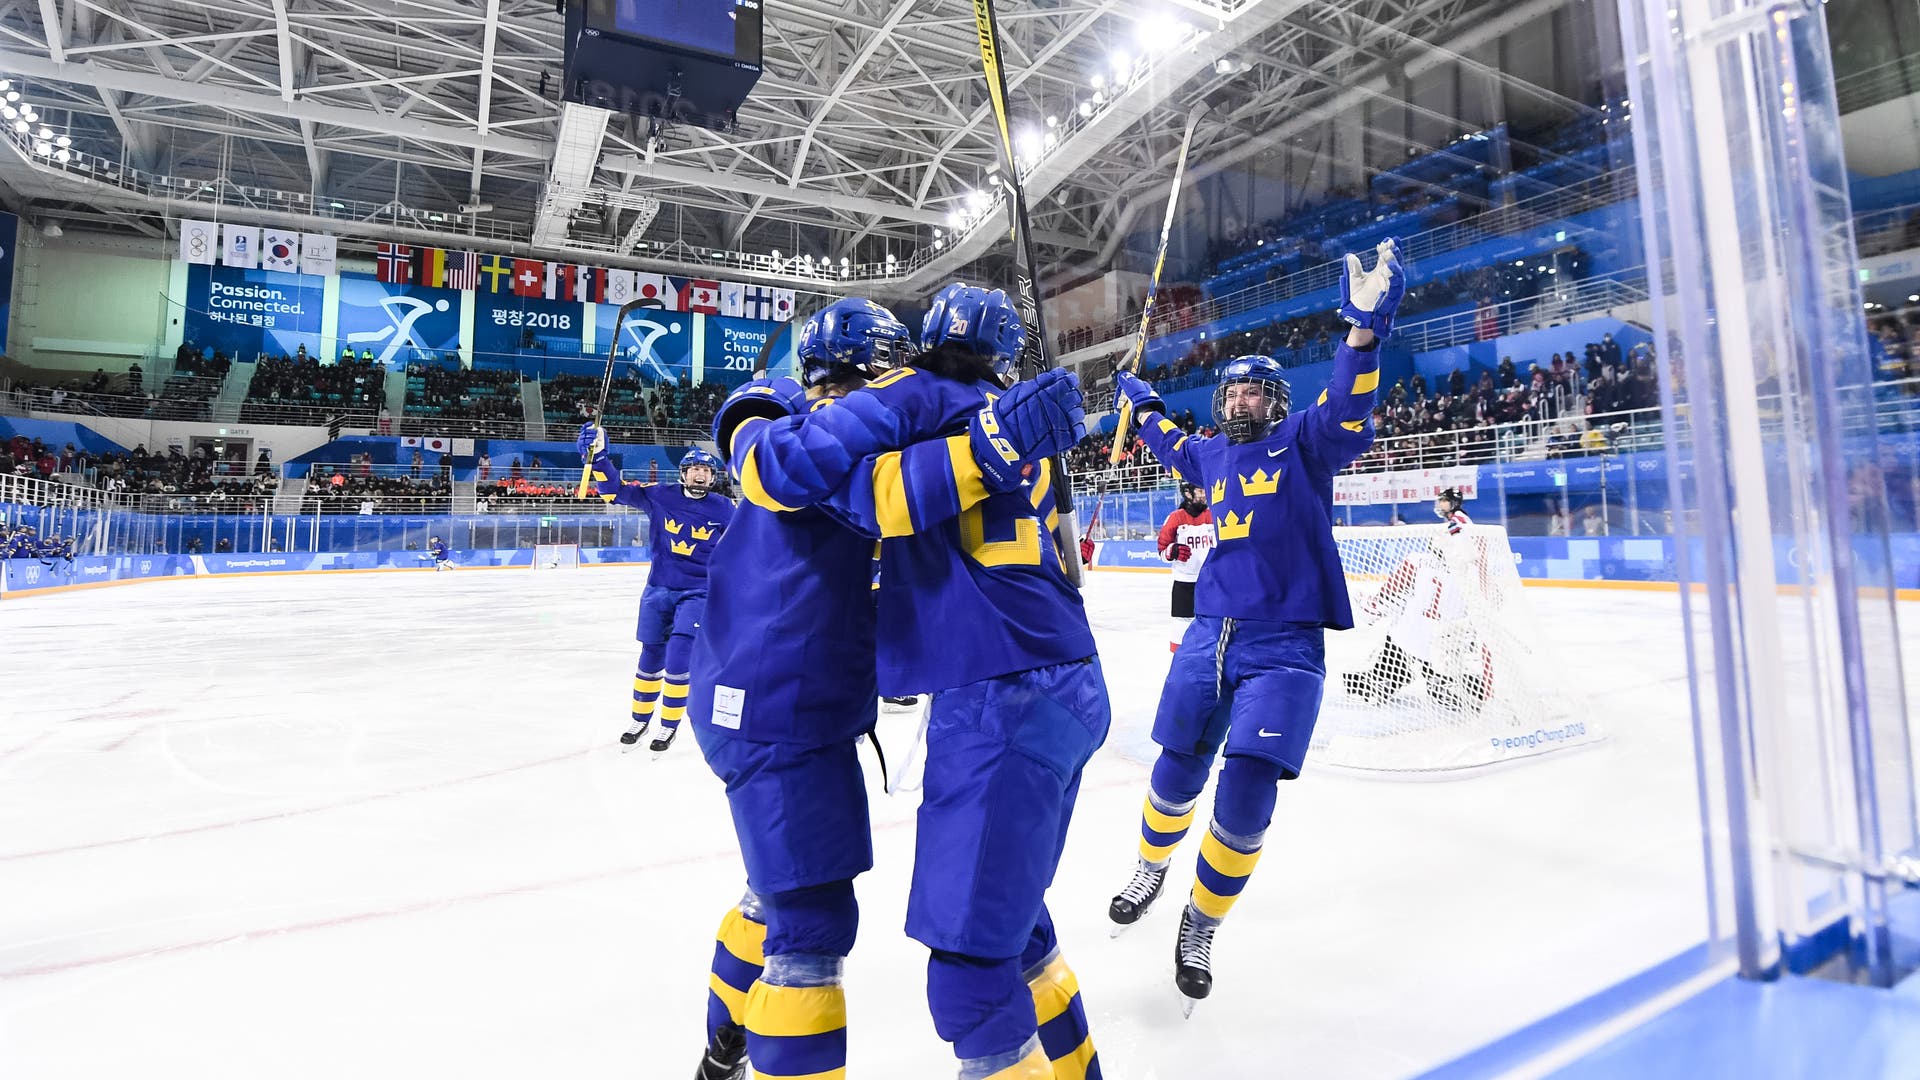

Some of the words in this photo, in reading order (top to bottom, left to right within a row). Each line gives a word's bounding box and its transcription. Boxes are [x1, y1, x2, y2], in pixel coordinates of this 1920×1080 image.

[975, 0, 994, 68] SUPR
[211, 282, 287, 301] Passion.
[210, 295, 305, 315] Connected.
[209, 311, 247, 324] 하나된
[251, 315, 276, 327] 열정
[492, 309, 525, 326] 평창
[526, 312, 571, 330] 2018
[948, 319, 969, 335] 20
[724, 328, 767, 344] Pyeong
[871, 327, 896, 337] CCM
[723, 355, 755, 372] 201
[983, 461, 1005, 482] SWEDEN
